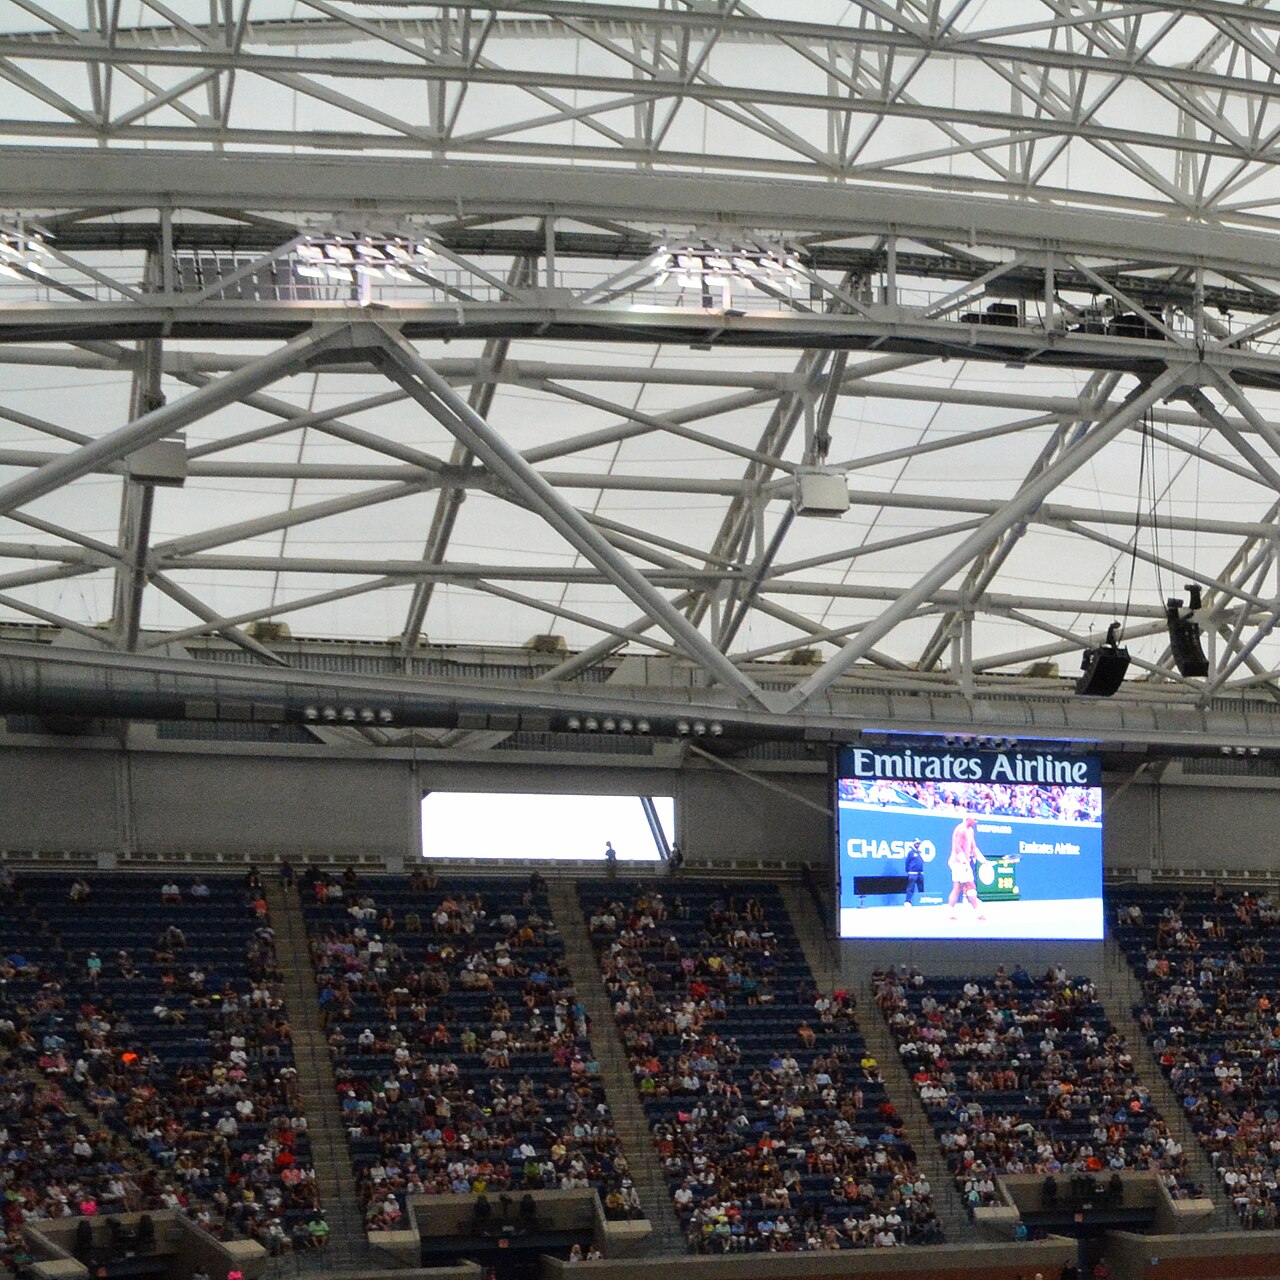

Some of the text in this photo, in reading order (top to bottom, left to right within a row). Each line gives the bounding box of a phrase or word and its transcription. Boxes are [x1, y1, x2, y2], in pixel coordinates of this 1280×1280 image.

[853, 748, 1087, 783] Emirates Airline
[1019, 841, 1053, 854] Emirates
